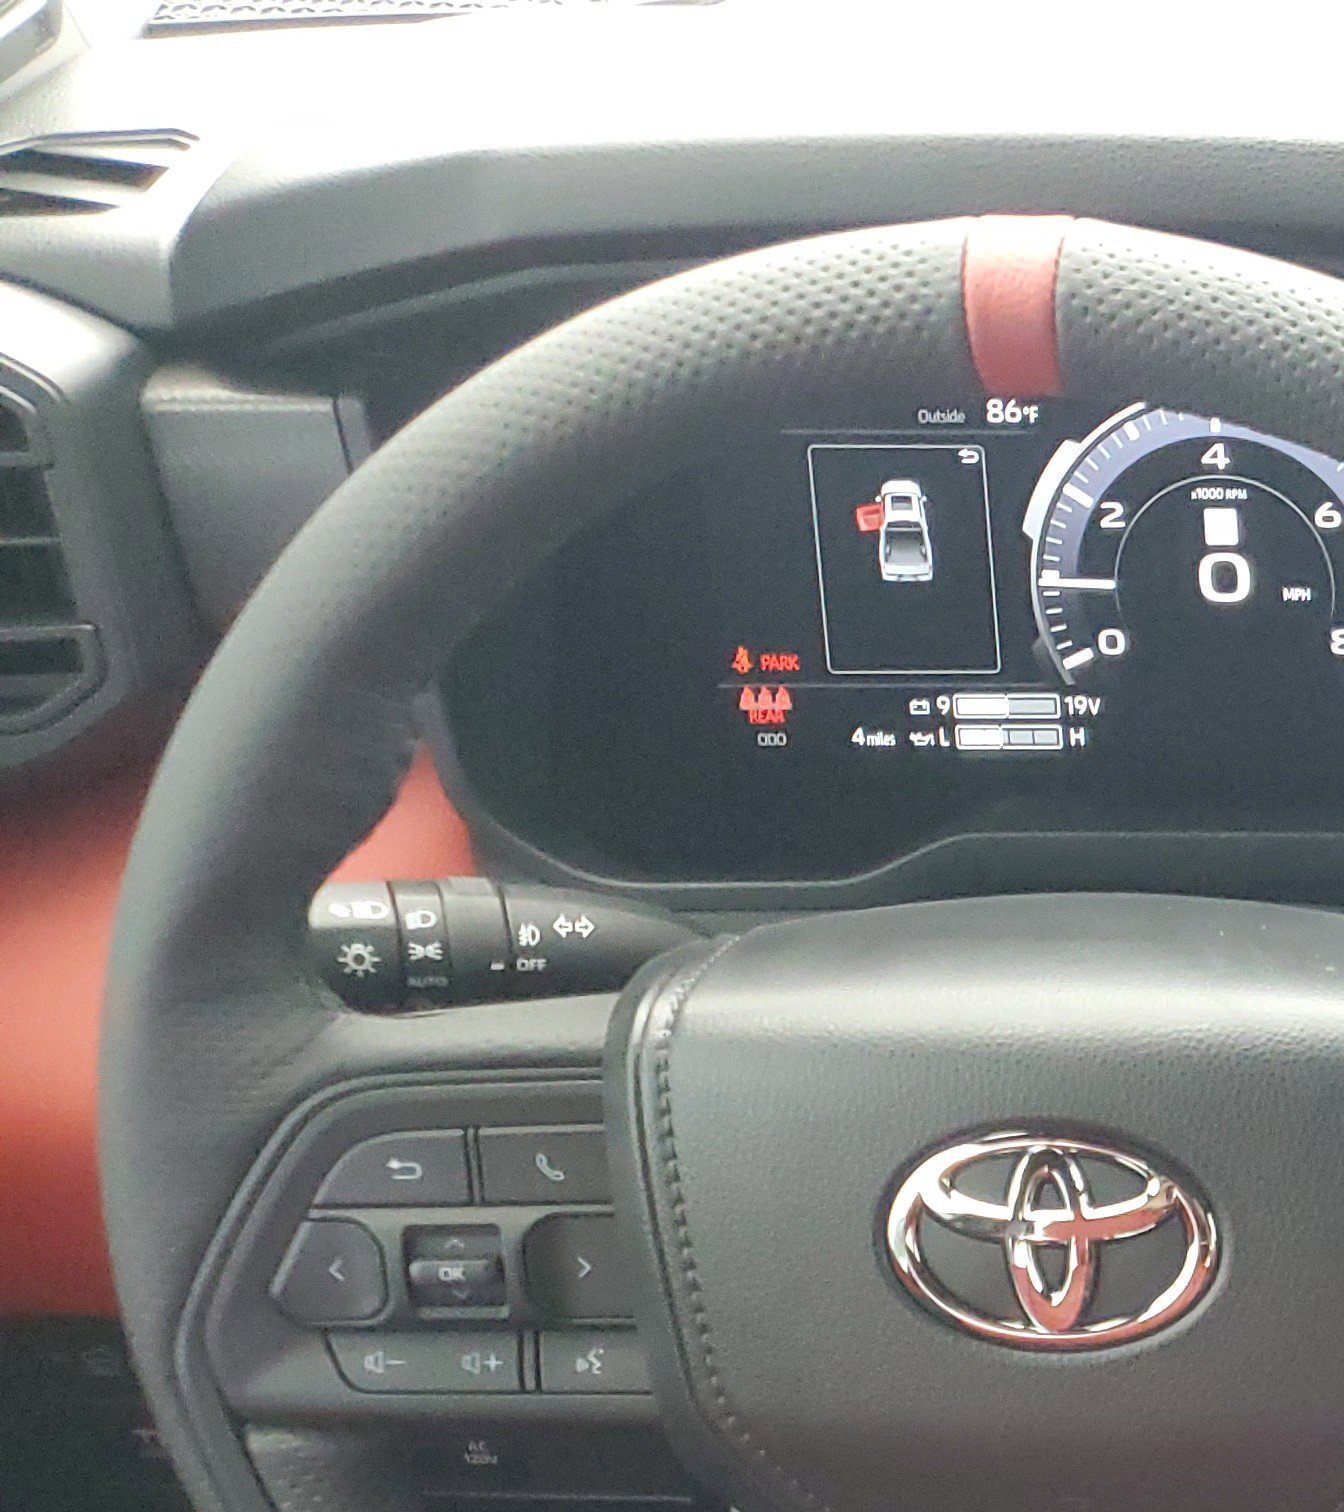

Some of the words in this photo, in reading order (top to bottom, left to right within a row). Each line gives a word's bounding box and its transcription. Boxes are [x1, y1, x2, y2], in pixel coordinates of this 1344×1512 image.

[918, 409, 965, 424] Outside
[1201, 443, 1230, 470] 4
[1226, 487, 1248, 500] RPM
[1100, 502, 1126, 529] 2
[1314, 502, 1342, 529] 6
[1198, 552, 1251, 603] 0
[1282, 587, 1312, 601] MPH
[1098, 629, 1126, 655] 0
[760, 654, 800, 672] PARK
[936, 697, 950, 716] 9
[1064, 697, 1101, 716] 19V
[851, 726, 865, 745] 4
[866, 727, 897, 747] miles
[938, 727, 950, 747] L
[1070, 727, 1087, 748] H
[516, 958, 547, 972] OFF
[438, 1266, 467, 1282] OK
